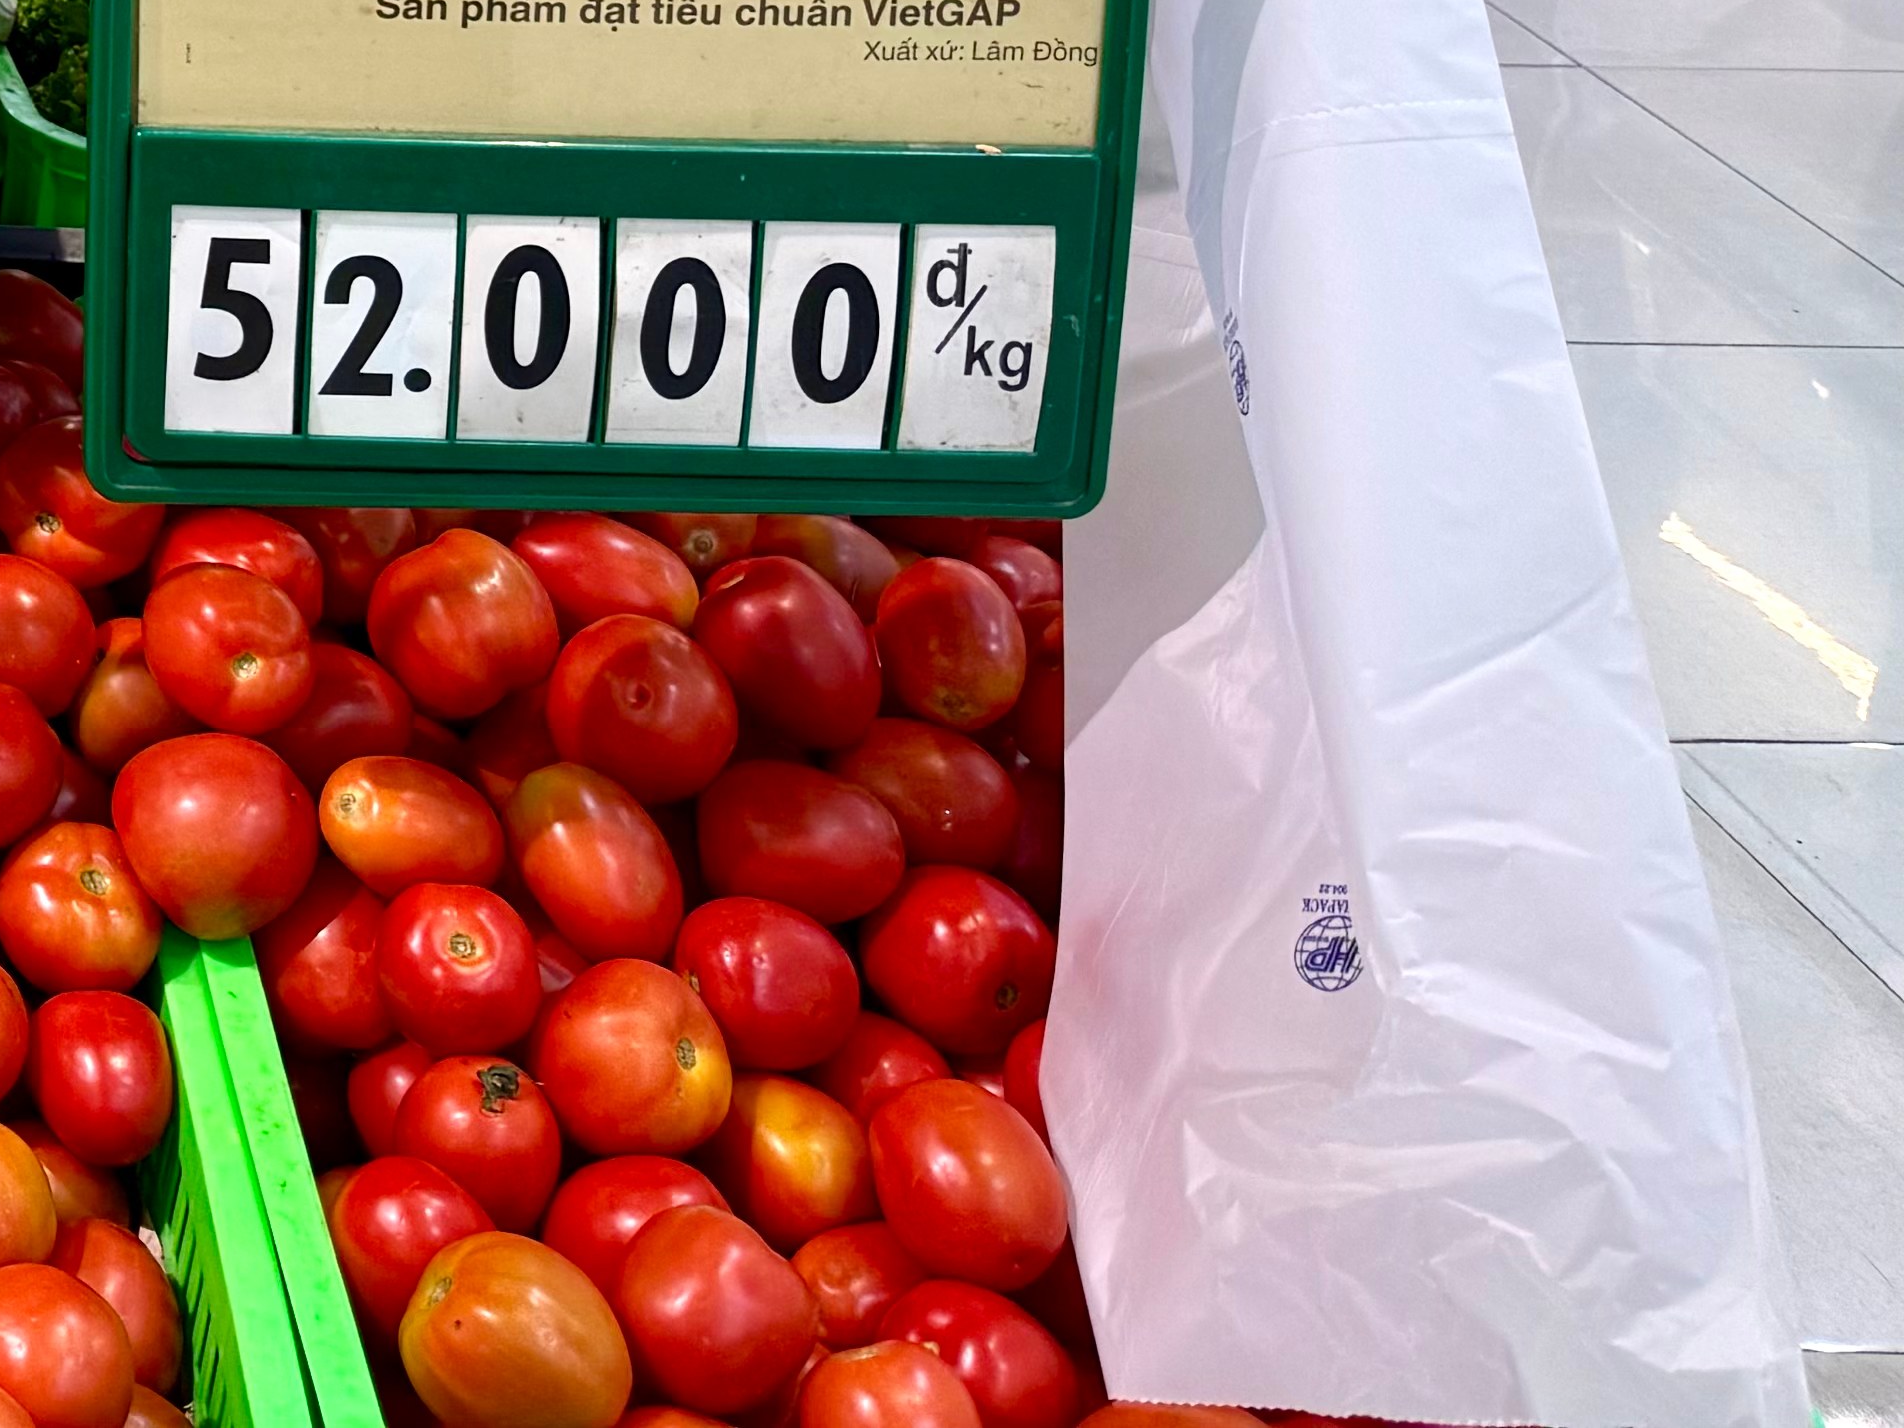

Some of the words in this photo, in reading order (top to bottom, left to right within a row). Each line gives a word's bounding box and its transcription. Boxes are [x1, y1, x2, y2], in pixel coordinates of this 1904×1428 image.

[863, 39, 919, 63] Xuất
[924, 40, 967, 63] xứ:
[970, 40, 1026, 64] Lâm
[1031, 37, 1099, 68] Đồng
[193, 235, 882, 406] 52.000
